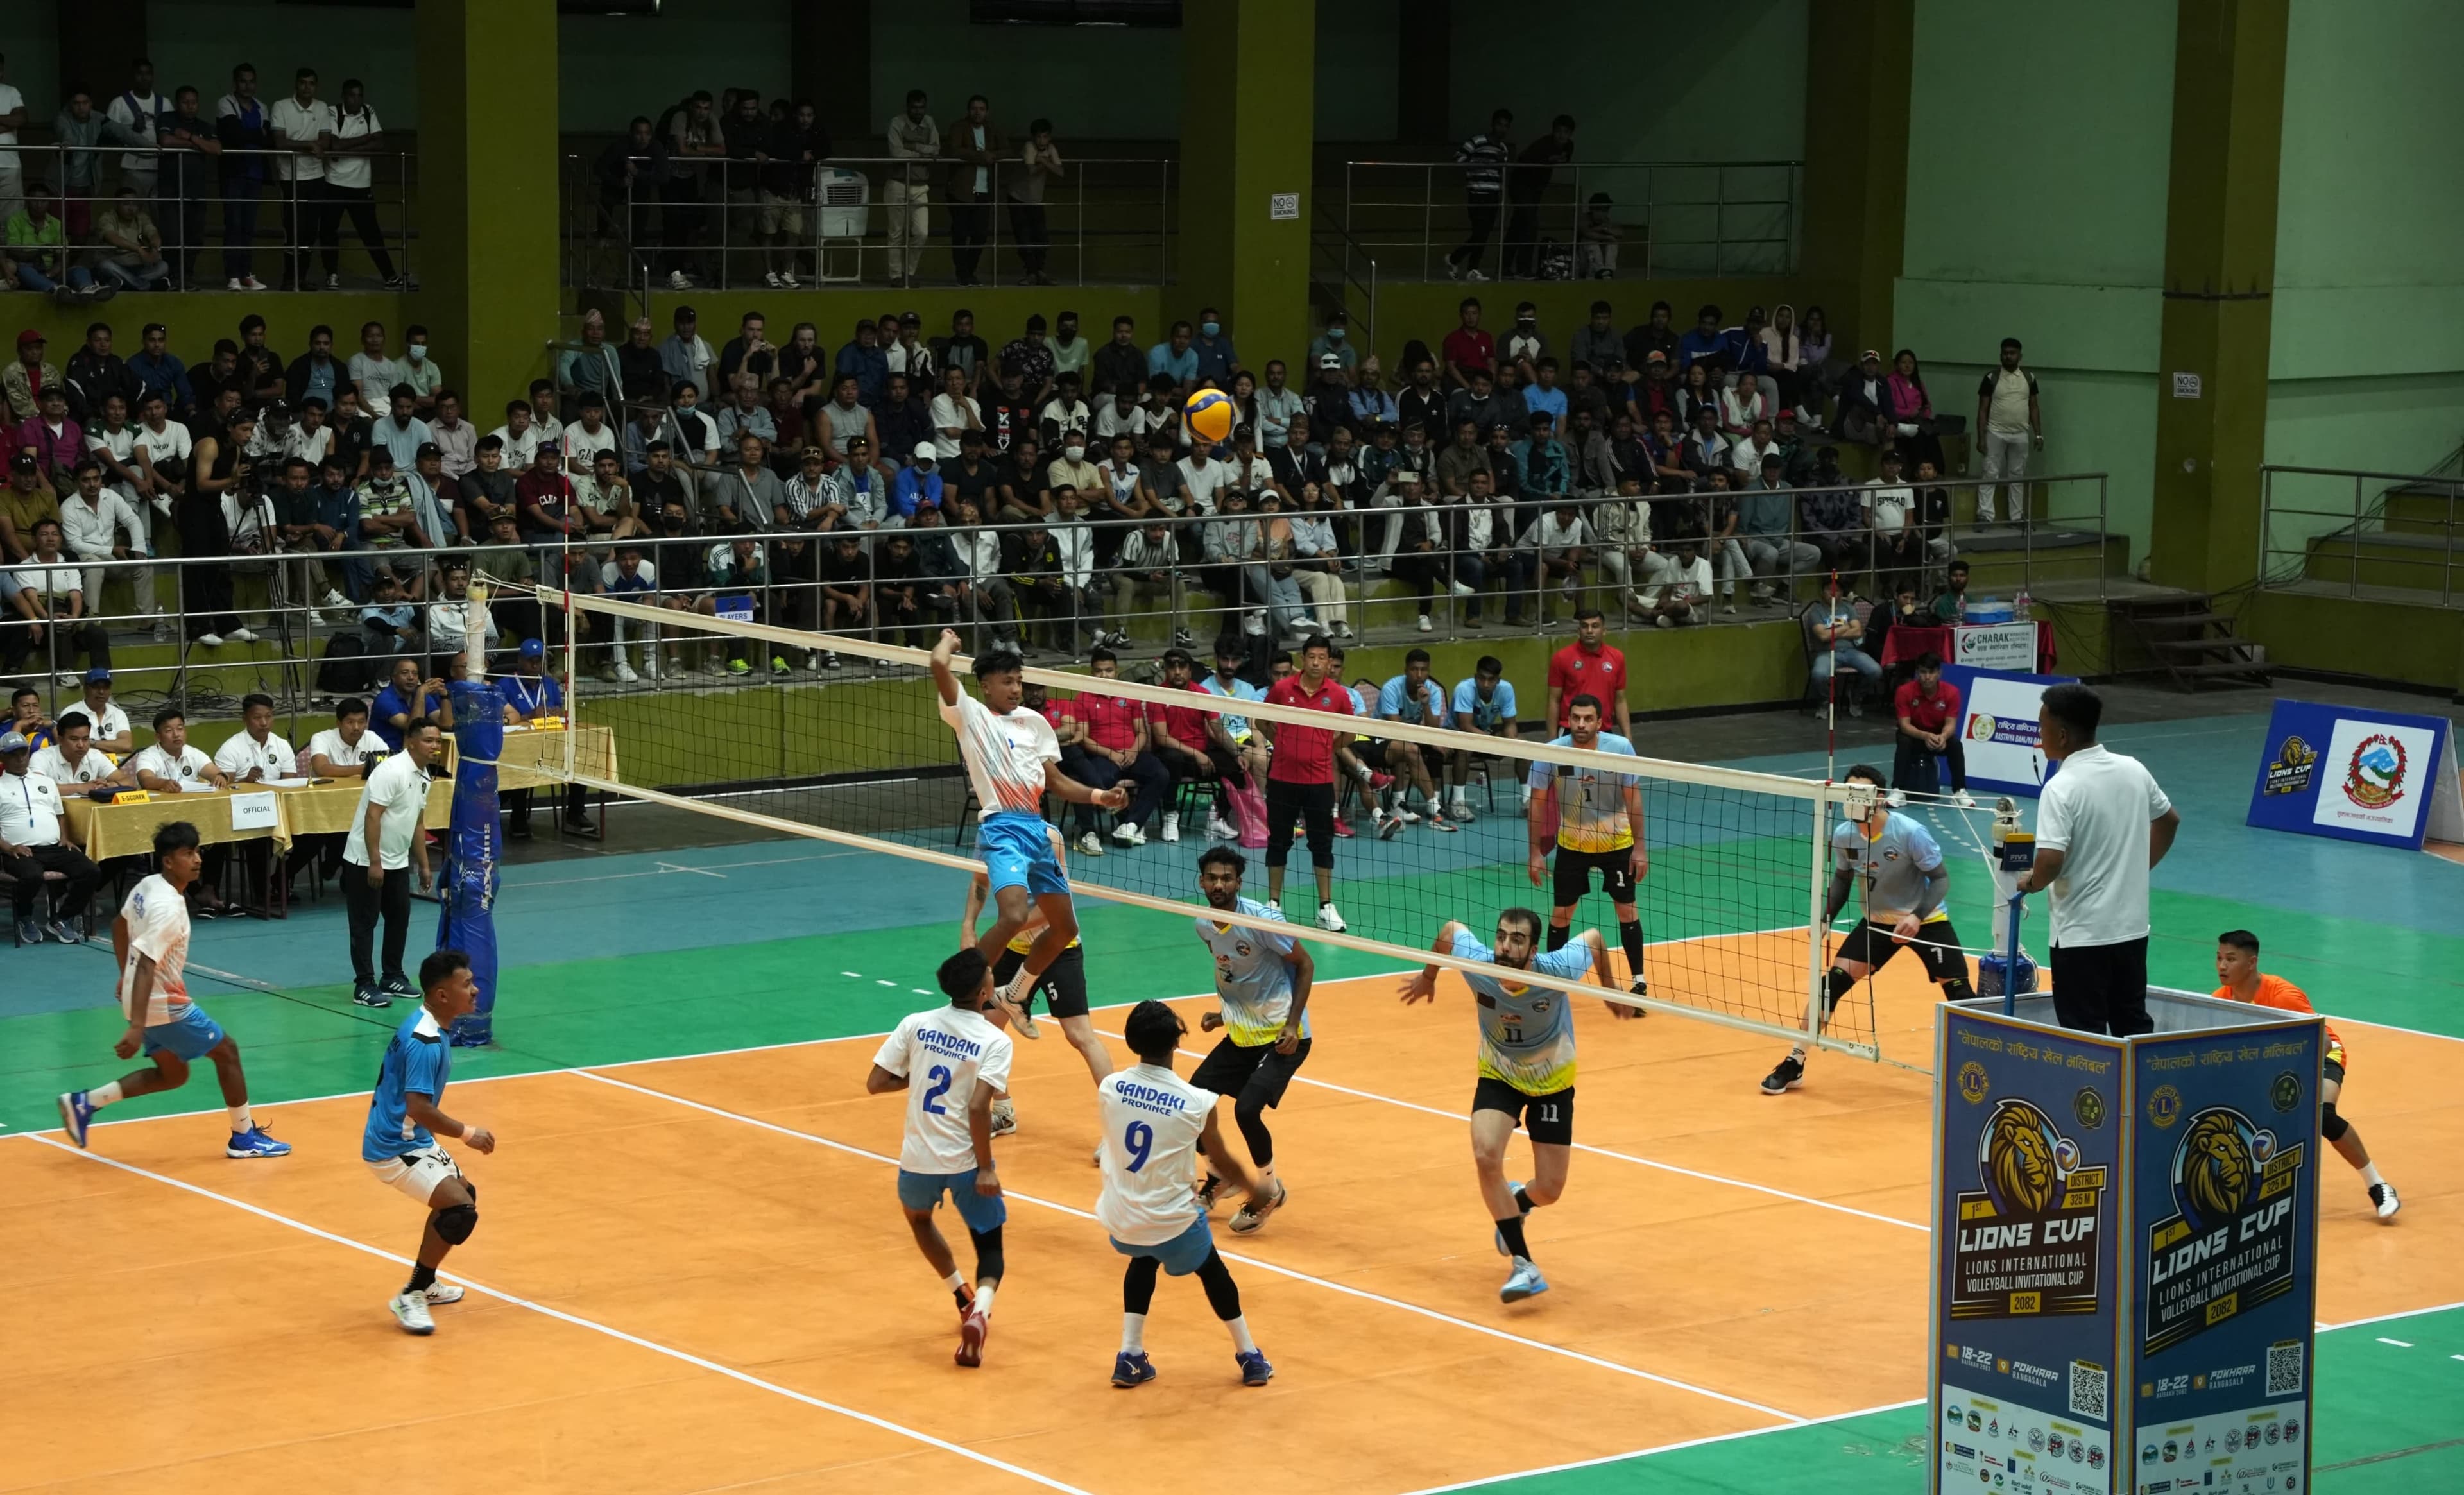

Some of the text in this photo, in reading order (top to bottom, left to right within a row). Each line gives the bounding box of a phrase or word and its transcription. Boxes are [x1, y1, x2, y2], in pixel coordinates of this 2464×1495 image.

[1274, 198, 1285, 207] NO
[2177, 377, 2188, 385] NO
[1878, 497, 1905, 506] SPREAD
[1977, 633, 2009, 644] CHARAK
[1995, 733, 2015, 742] RASTRIYA
[2015, 735, 2033, 744] BANIJYA
[2269, 764, 2311, 778] LIONS CUP
[1584, 789, 1592, 802] 1
[243, 805, 271, 814] OFFICIAL
[1616, 871, 1625, 887] 1
[1930, 947, 1943, 964] 7
[1047, 981, 1058, 1001] 5
[917, 1029, 981, 1057] GANDAKI
[1504, 1028, 1524, 1043] 11
[924, 1044, 968, 1062] PROVINCE
[2042, 1047, 2064, 1065] खेल
[2238, 1046, 2259, 1061] खेल
[1964, 1063, 1984, 1075] LIONS
[923, 1064, 952, 1115] 2
[1971, 1075, 1978, 1089] L
[1116, 1080, 1186, 1110] GANDAKI
[1122, 1097, 1172, 1116] PROVINCE
[1541, 1104, 1559, 1122] 11
[2161, 1099, 2169, 1113] L
[1125, 1120, 1153, 1174] 9
[2267, 1152, 2296, 1175] DISTRICT
[2071, 1174, 2100, 1186] DISTRICT
[2266, 1178, 2287, 1194] 325 M
[2070, 1192, 2091, 1206] 325 M
[1972, 1203, 1981, 1218] 1ST
[1959, 1217, 2095, 1252] LIONS CUP
[2153, 1196, 2291, 1285] LIONS CUP
[2165, 1226, 2175, 1246] 1ST
[1966, 1252, 2087, 1275] LIONS INTERNATIONAL
[2159, 1235, 2283, 1306] LIONS INTERNATIONAL
[1967, 1270, 2084, 1292] VOLLEYBALL INVITATIONAL CUP
[2161, 1254, 2280, 1322] VOLLEYBALL INVITATIONAL CUP
[2014, 1296, 2035, 1310] 2082
[2211, 1299, 2232, 1319] 2082
[1962, 1346, 1992, 1365] 18-22
[2012, 1371, 2047, 1388] RANGASALA
[2013, 1361, 2059, 1381] POKHARA
[2209, 1364, 2256, 1380] POKHARA
[2157, 1375, 2189, 1392] 18-22
[2209, 1377, 2244, 1390] RANGASALA
